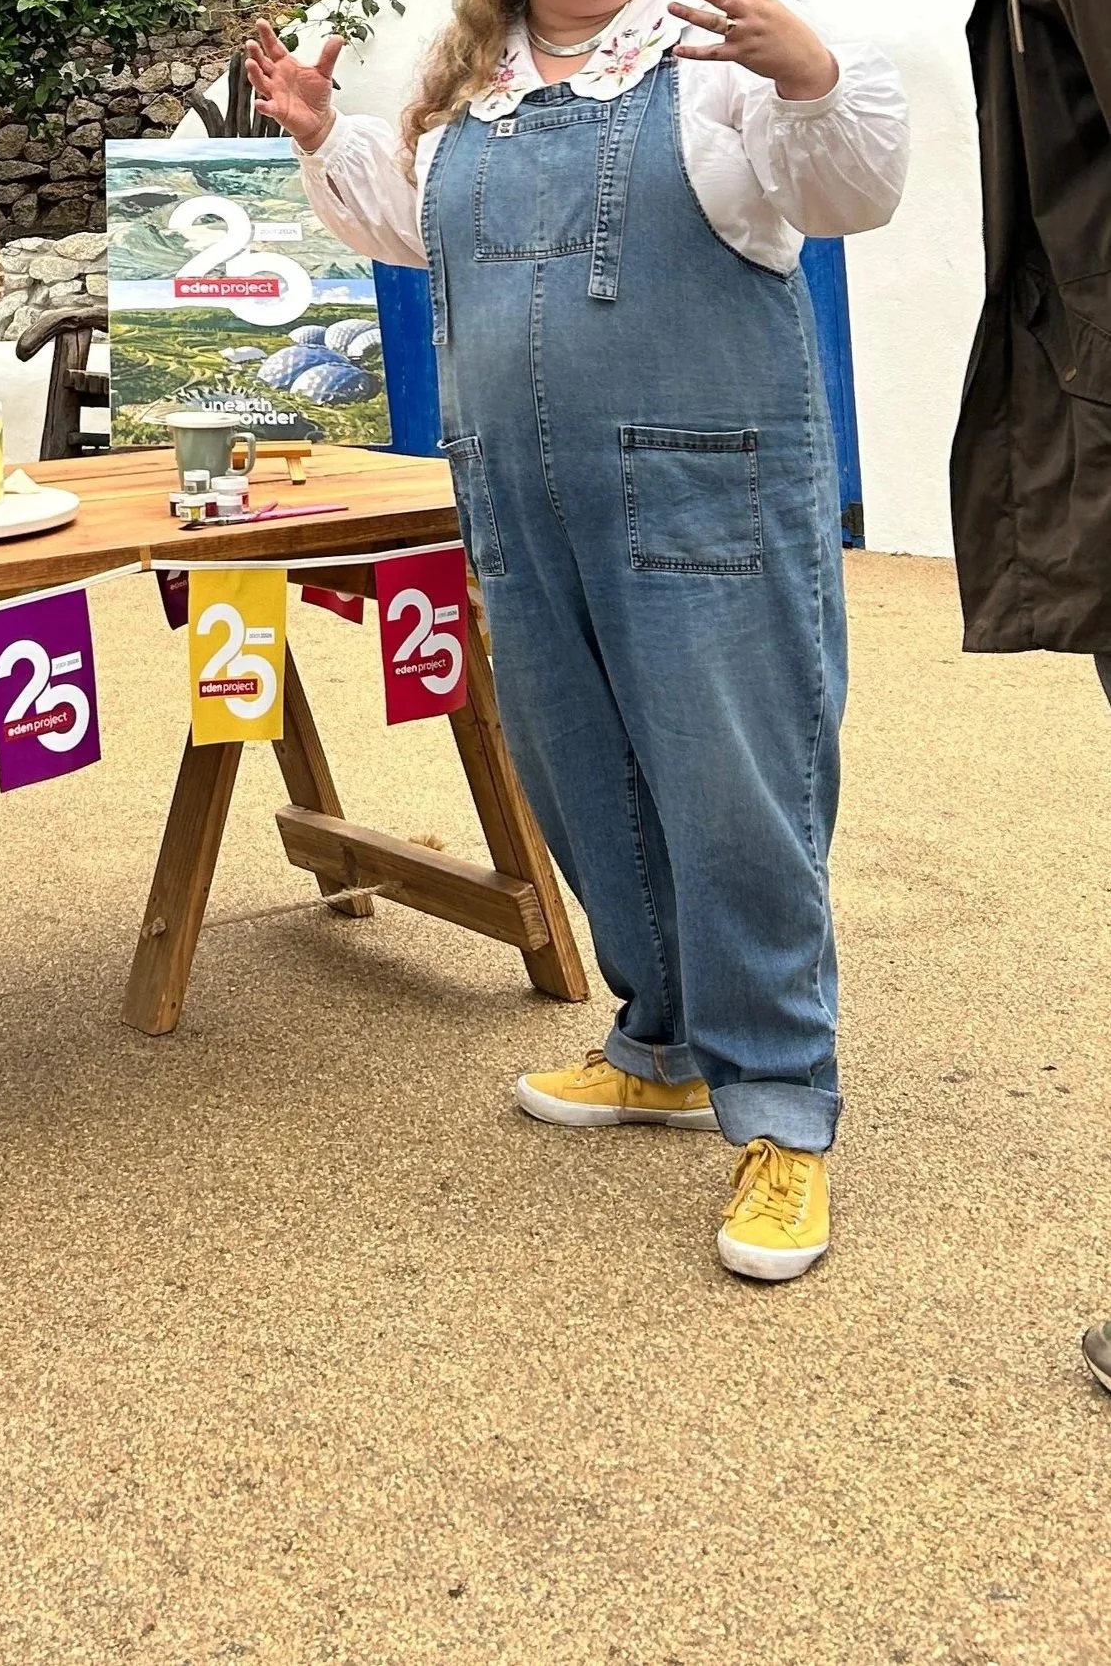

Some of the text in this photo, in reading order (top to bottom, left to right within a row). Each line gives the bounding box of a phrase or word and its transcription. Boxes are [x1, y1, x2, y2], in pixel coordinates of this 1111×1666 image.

[169, 195, 312, 326] 25
[180, 282, 273, 296] eden project
[201, 398, 272, 412] unearth
[239, 411, 298, 425] onder
[387, 588, 463, 695] 25
[196, 602, 277, 719] 25
[395, 658, 447, 676] eden project
[201, 681, 255, 693] eden project
[8, 711, 68, 737] eden project
